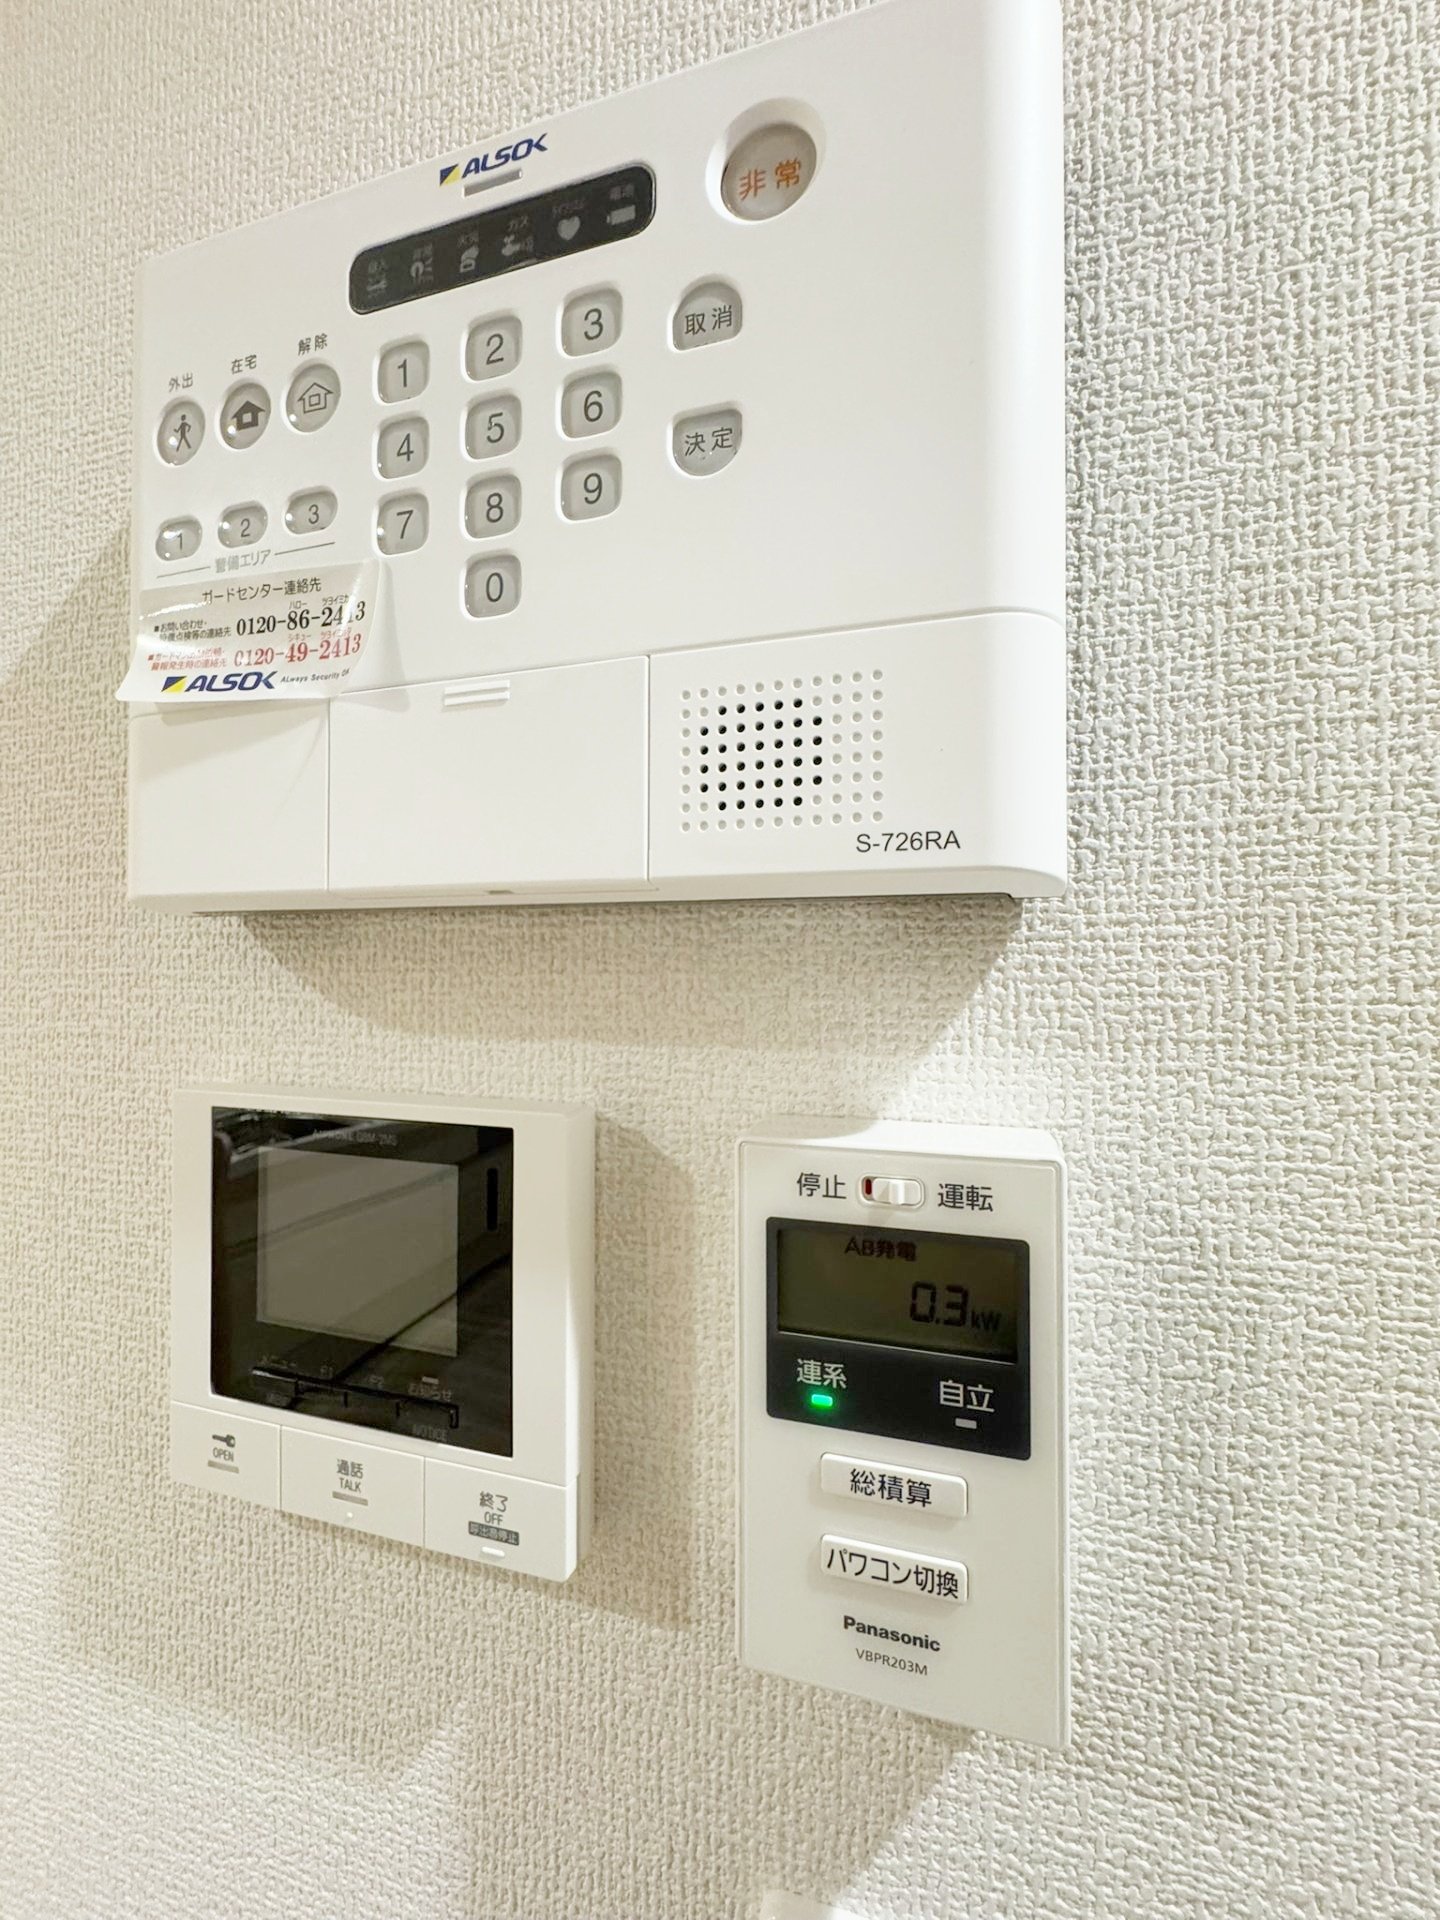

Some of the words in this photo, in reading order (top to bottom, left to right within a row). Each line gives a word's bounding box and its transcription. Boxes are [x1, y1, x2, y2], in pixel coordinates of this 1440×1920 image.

[461, 133, 548, 178] ALSOK
[739, 157, 802, 201] 非常
[583, 308, 604, 341] 3
[684, 304, 733, 336] 取消
[297, 333, 328, 356] 解除
[485, 333, 505, 365] 2
[231, 354, 258, 375] 在宅
[397, 359, 408, 388] 1
[168, 373, 194, 392] 外出
[583, 390, 604, 423] 6
[485, 411, 506, 445] 5
[684, 427, 734, 457] 決定
[396, 433, 415, 462] 4
[583, 472, 604, 505] 9
[307, 503, 321, 525] 3
[484, 491, 506, 525] 8
[239, 517, 252, 538] 2
[396, 509, 415, 540] 7
[175, 532, 184, 551] 1
[215, 550, 271, 573] 警備エリア
[201, 577, 322, 604] ガードセンター連絡先
[484, 571, 506, 604] 0
[234, 633, 362, 667] 0120-49-2413
[184, 670, 278, 693] ALSOK
[311, 671, 340, 681] Security
[856, 830, 961, 853] S-726RA
[797, 1172, 846, 1199] 停止
[938, 1183, 993, 1212] 運転
[796, 1359, 846, 1388] 連系
[940, 1380, 995, 1412] 自立
[212, 1446, 234, 1463] OPEN
[336, 1458, 363, 1480] 通話
[338, 1476, 361, 1494] TALK
[849, 1468, 933, 1508] 総積算
[479, 1490, 508, 1513] 終了
[484, 1511, 503, 1526] OFF
[826, 1547, 959, 1599] パワコン切換
[843, 1615, 941, 1652] Panasonic
[855, 1648, 928, 1676] VBPR203M
